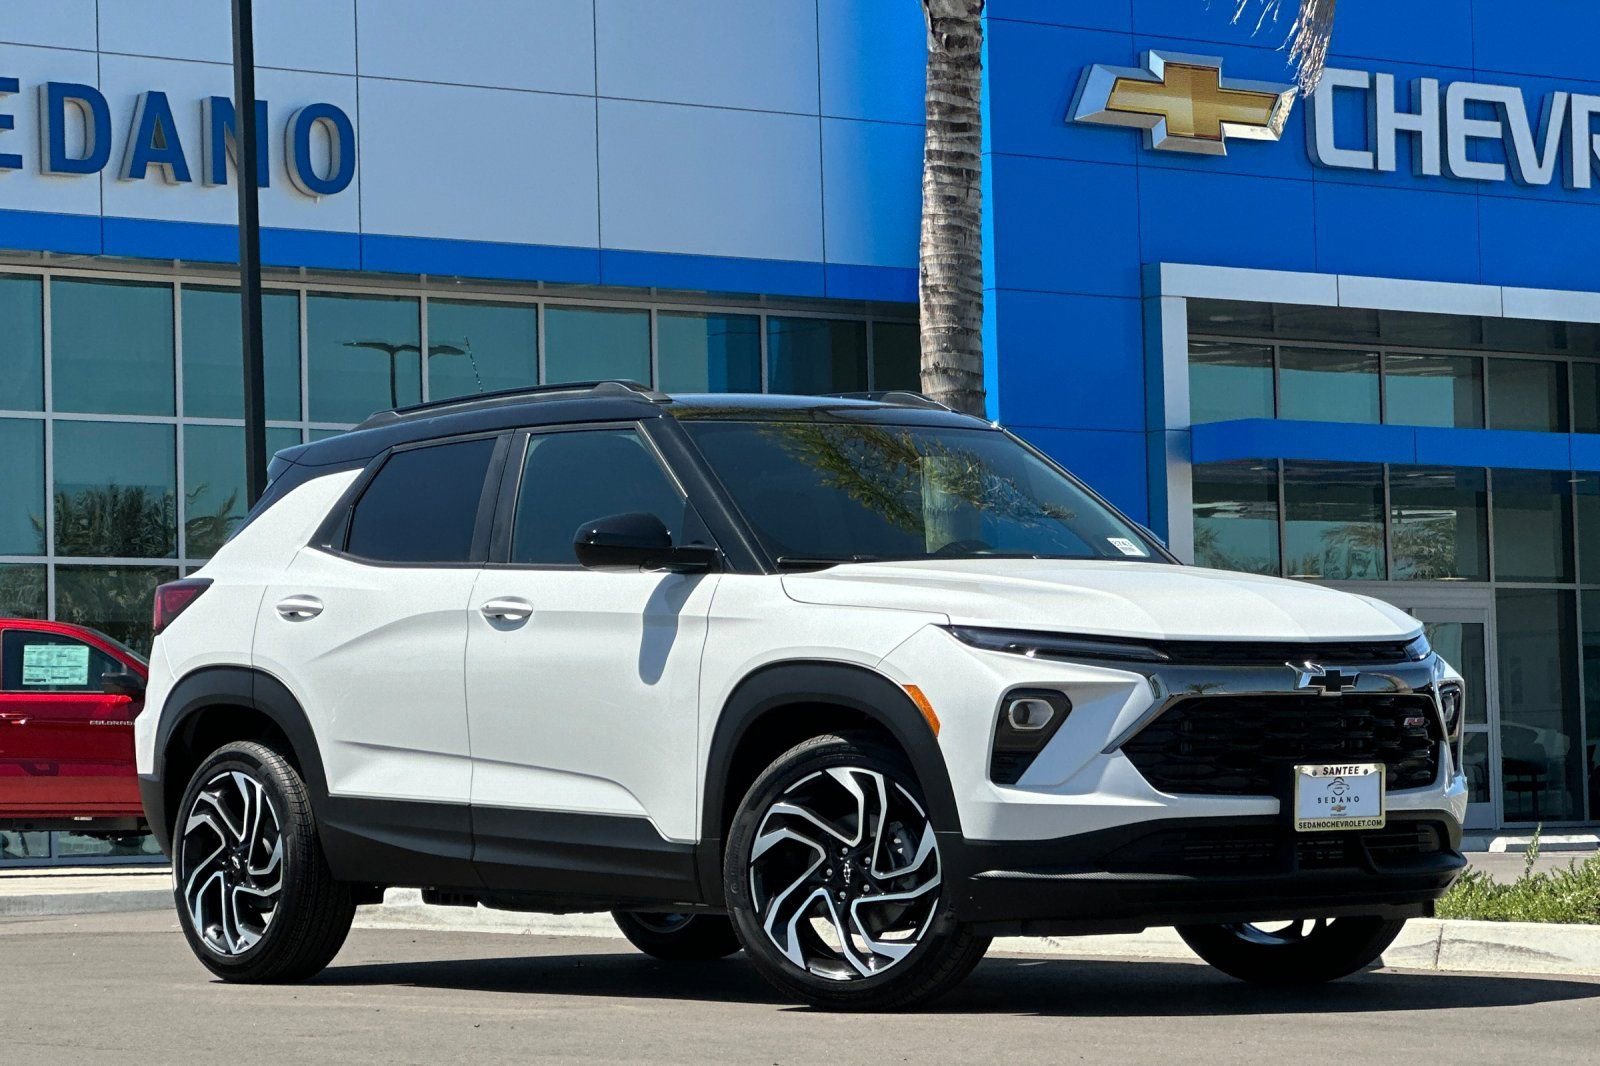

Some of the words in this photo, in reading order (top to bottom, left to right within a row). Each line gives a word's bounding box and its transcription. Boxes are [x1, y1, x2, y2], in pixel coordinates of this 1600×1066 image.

[1322, 766, 1360, 776] SANTEE
[1317, 796, 1360, 804] SEDANO
[1298, 820, 1382, 829] SEDANOCHEVROLET.COM
